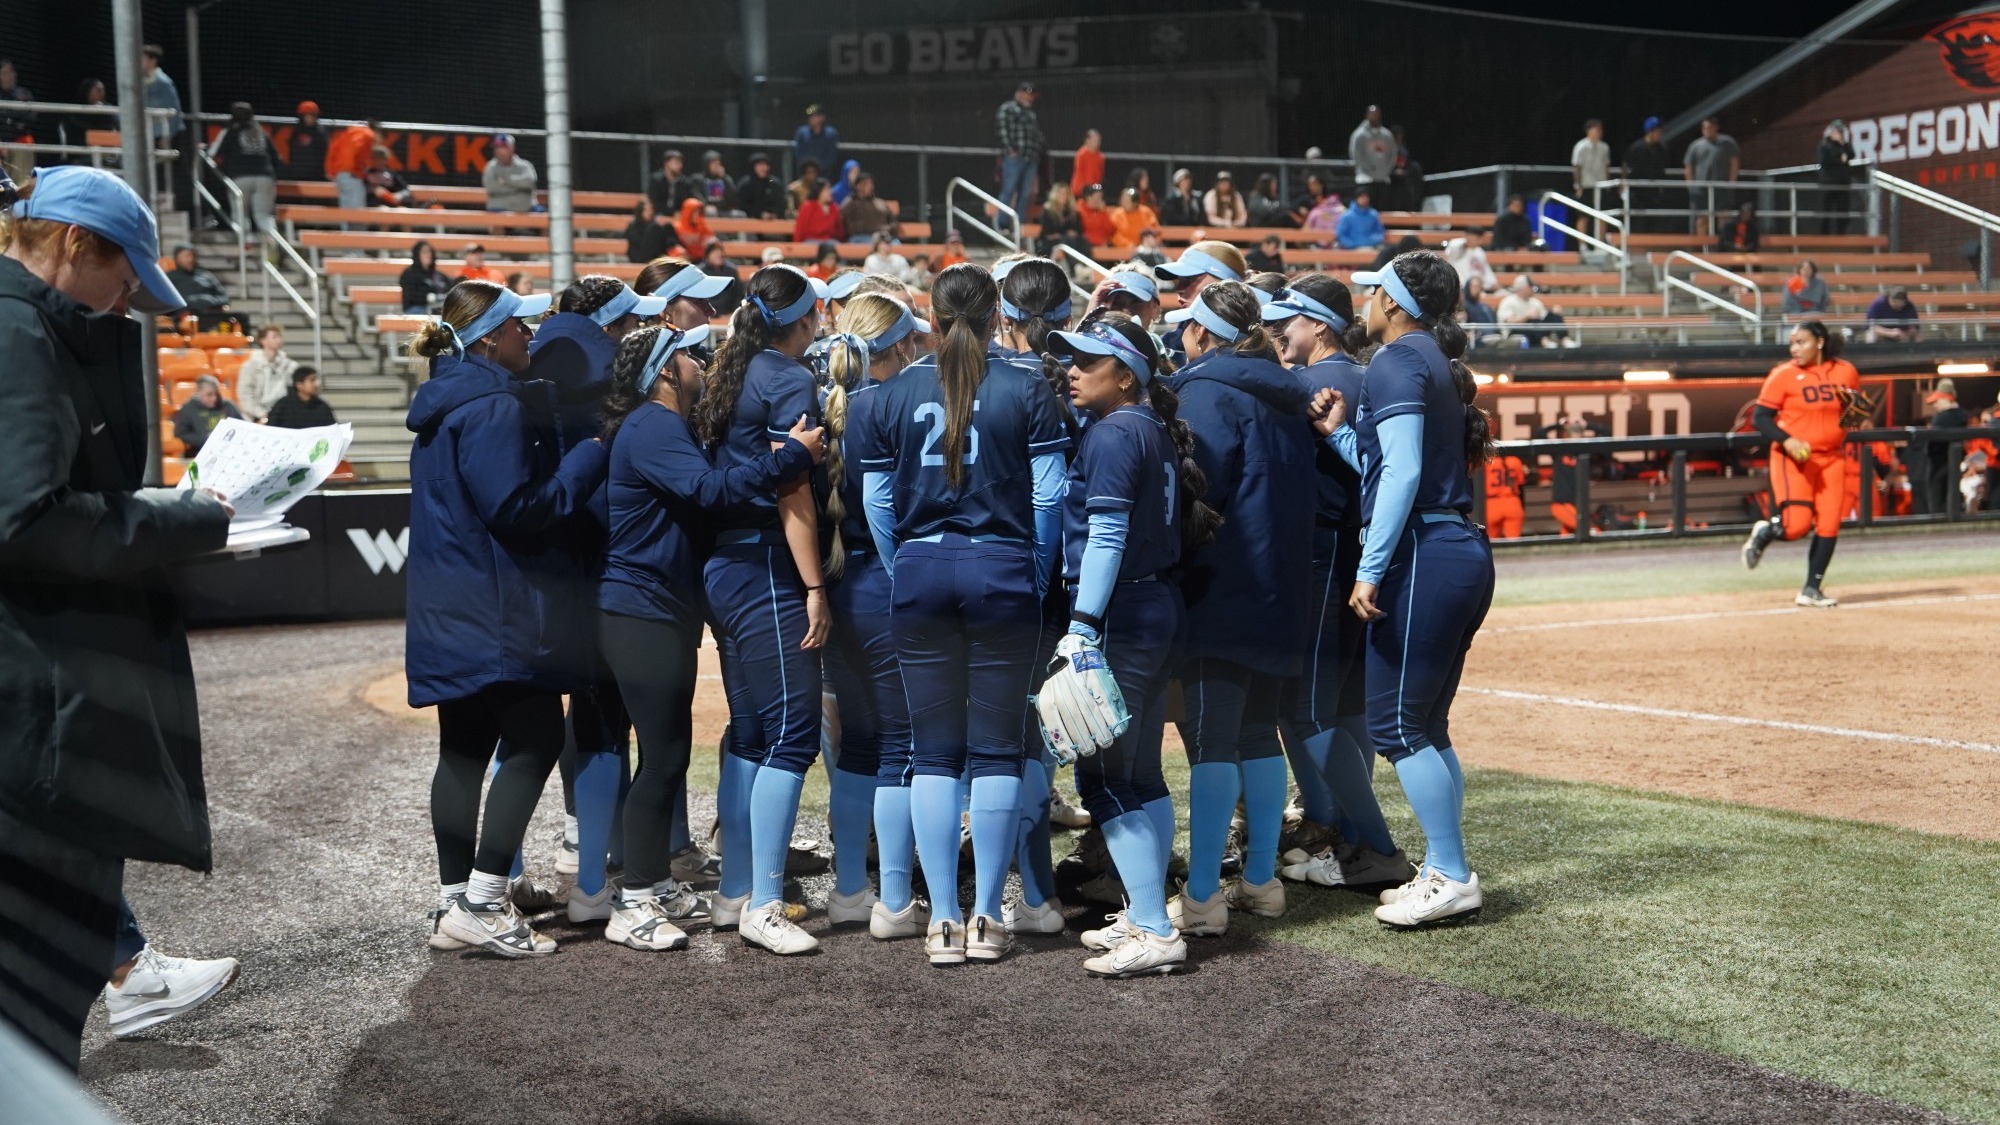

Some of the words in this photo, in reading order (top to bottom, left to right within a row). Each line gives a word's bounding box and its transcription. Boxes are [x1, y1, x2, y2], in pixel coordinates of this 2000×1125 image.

[829, 32, 893, 74] GO
[907, 24, 1079, 73] BEAVS
[1802, 384, 1846, 404] OS
